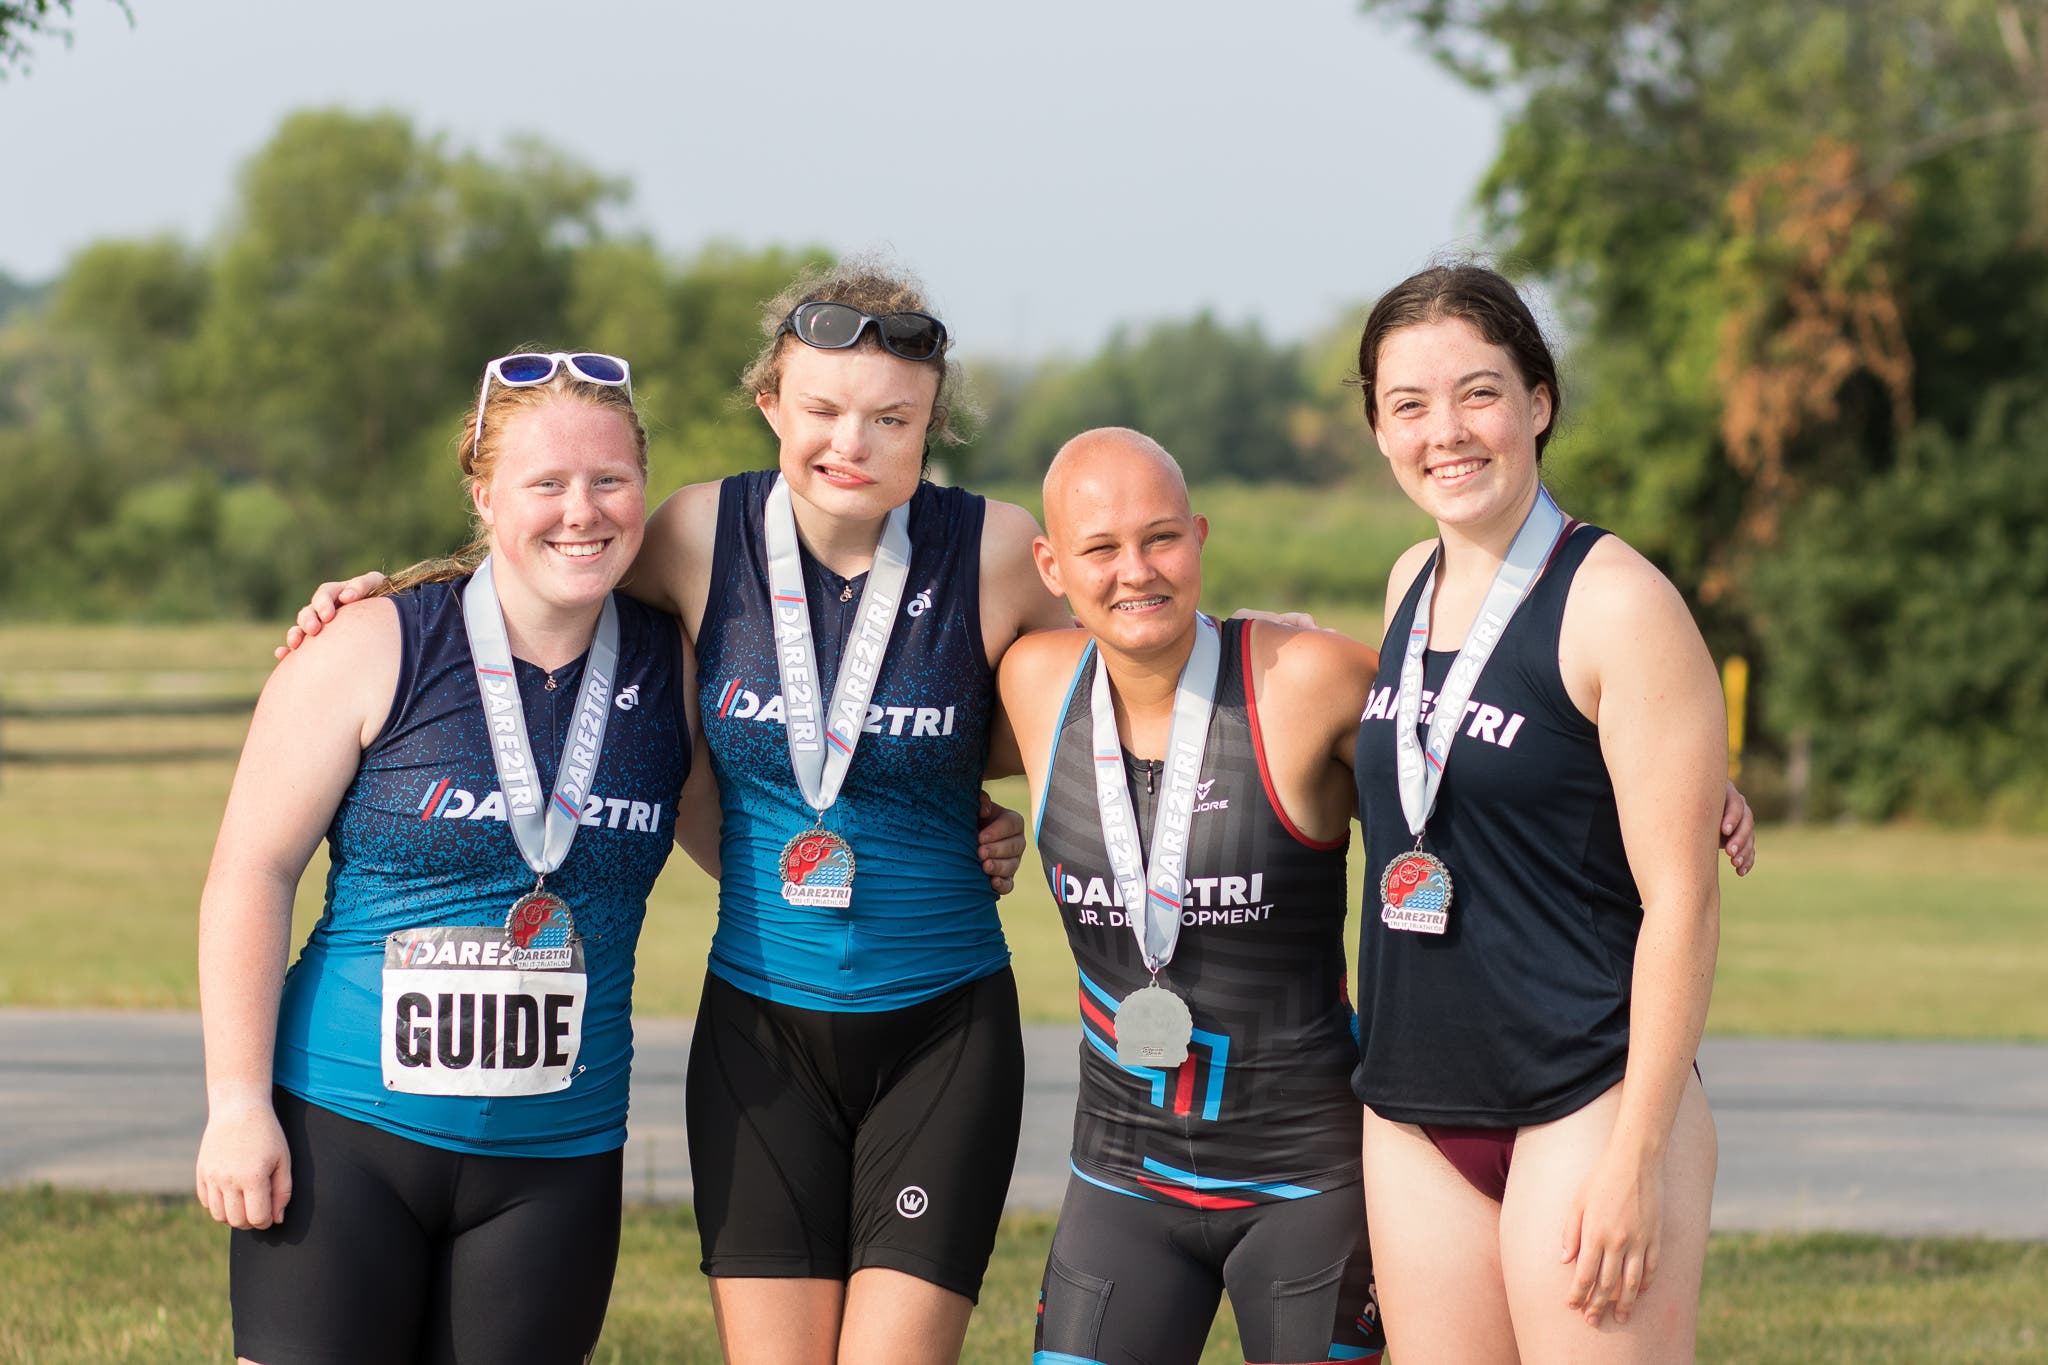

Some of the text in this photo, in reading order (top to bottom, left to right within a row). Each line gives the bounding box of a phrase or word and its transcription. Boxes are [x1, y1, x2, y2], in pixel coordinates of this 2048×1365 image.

[731, 689, 954, 736] DA2TRI
[778, 606, 819, 751] DARE2TRI
[833, 591, 895, 740] DARE2TRI
[1432, 612, 1503, 757] DARE2TRI
[484, 679, 537, 816] DARE2TRI
[562, 668, 611, 806] DARE2TRI
[440, 788, 661, 832] DA2TRI
[1099, 766, 1141, 911] DARE2TRI
[1156, 740, 1199, 896] DARE2TRI
[790, 887, 849, 899] DARE2TRI
[1079, 909, 1104, 927] JR.
[1388, 909, 1445, 925] DARE2TRI
[517, 950, 570, 960] DARE2TRI
[395, 992, 574, 1070] GUIDE
